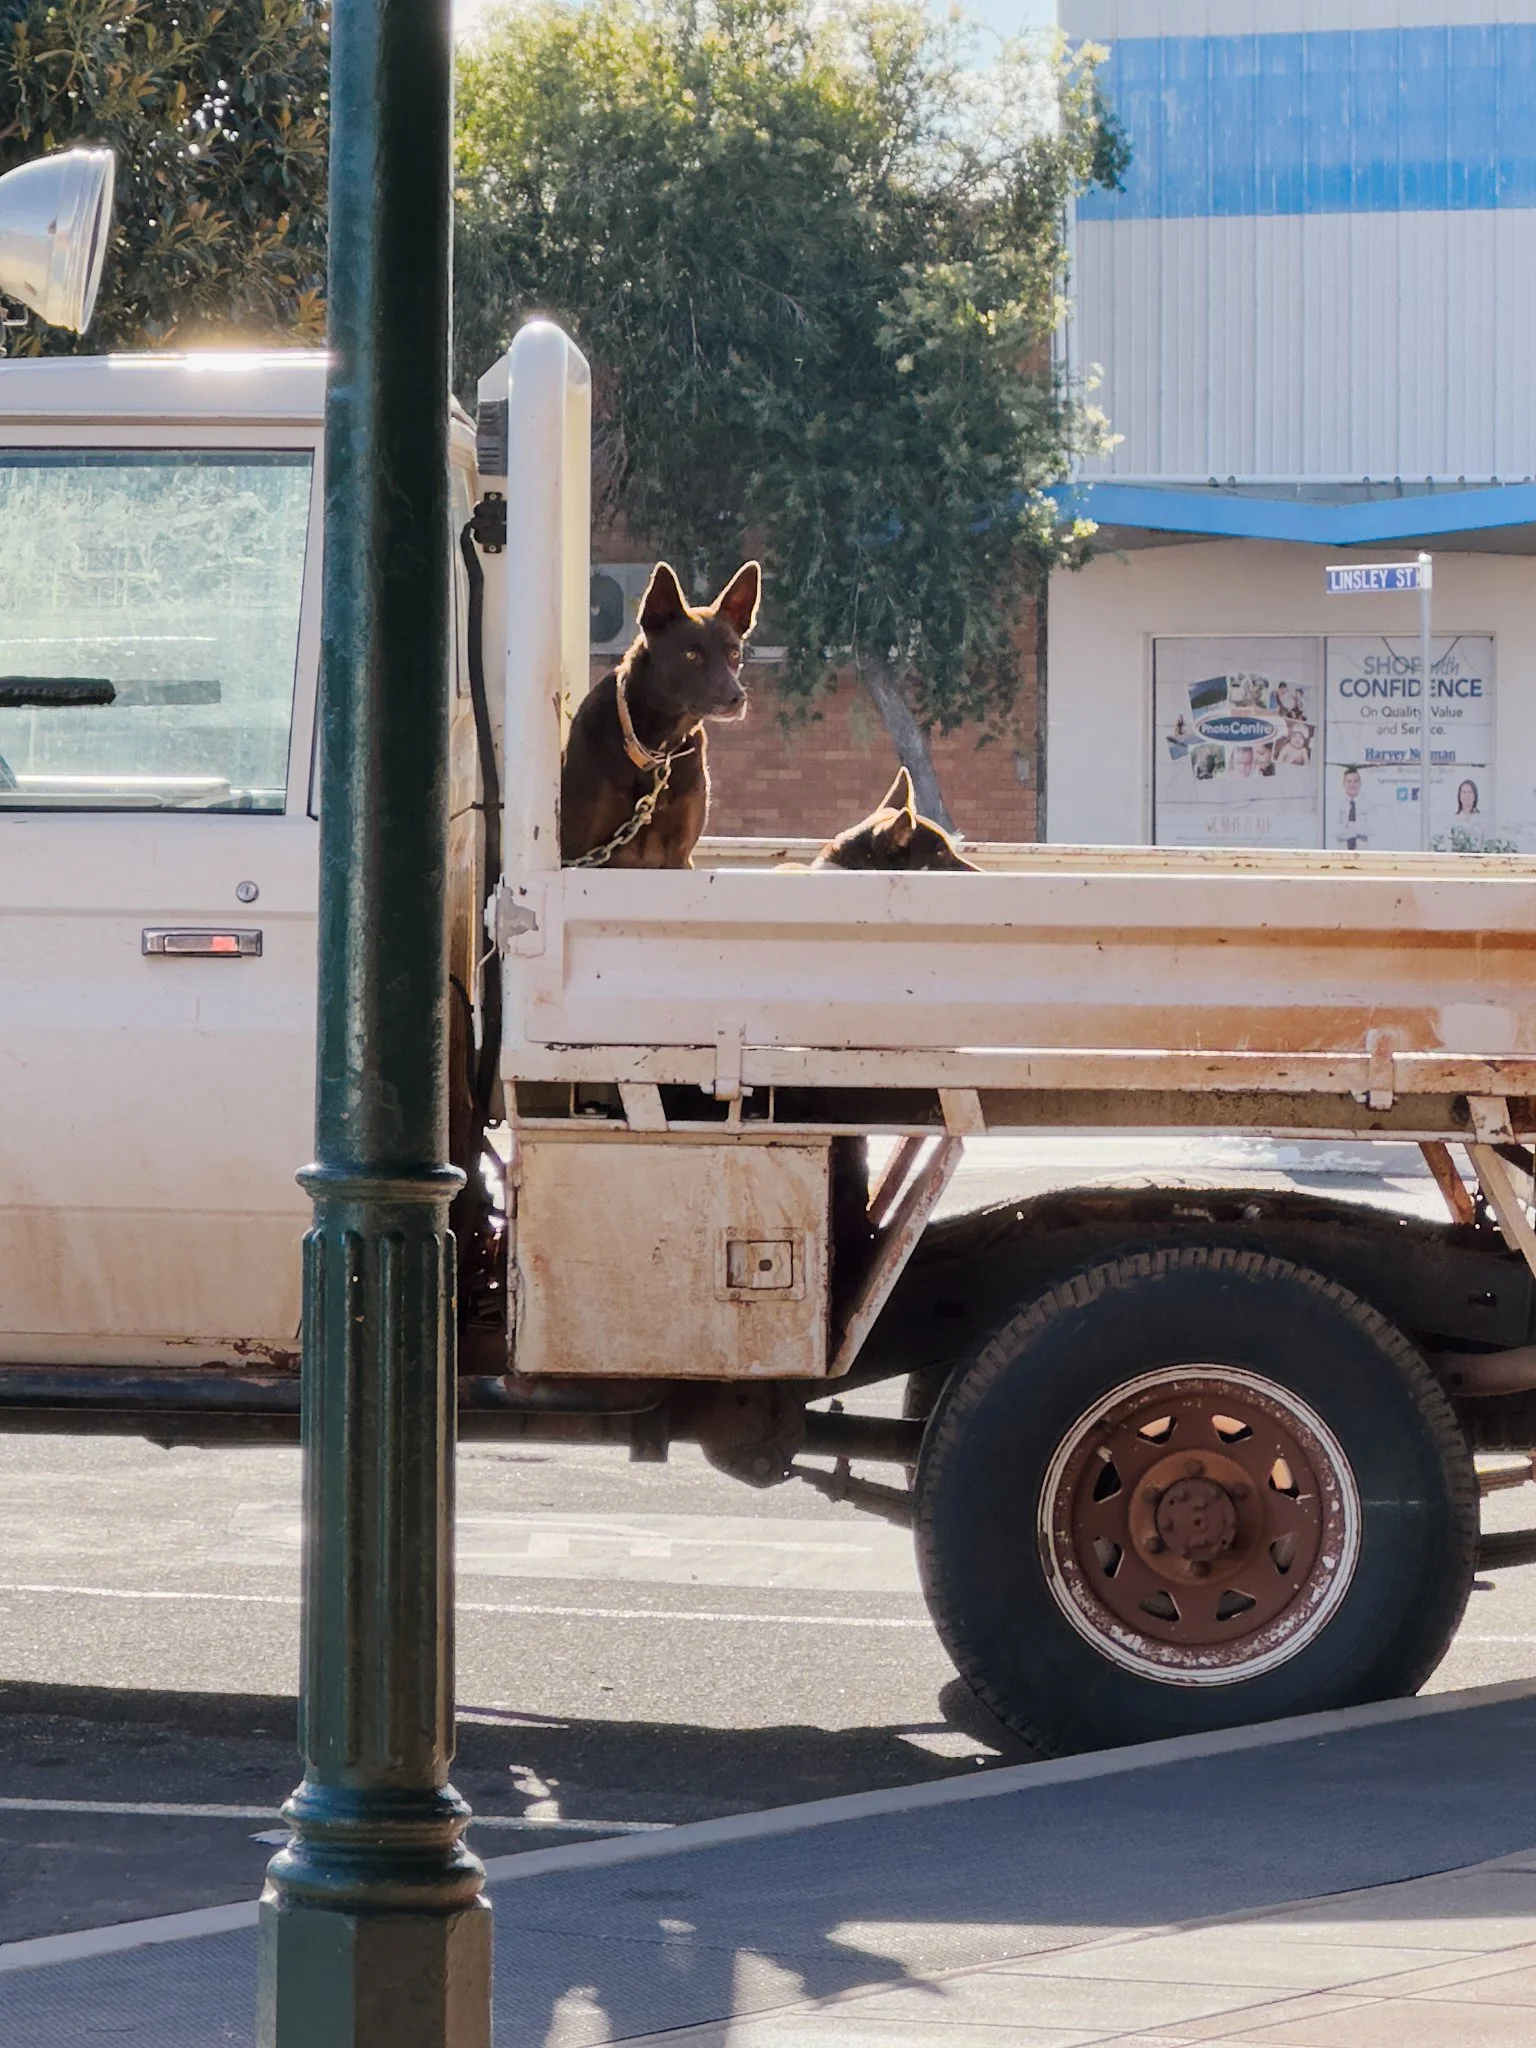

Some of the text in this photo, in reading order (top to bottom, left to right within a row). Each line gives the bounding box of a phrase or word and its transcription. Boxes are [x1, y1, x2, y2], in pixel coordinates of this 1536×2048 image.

[1331, 568, 1413, 590] LINSLEY ST
[1360, 705, 1377, 718] On
[1430, 704, 1463, 718] Value
[1376, 722, 1447, 736] and Serce.
[1365, 748, 1456, 762] Harvey Nman
